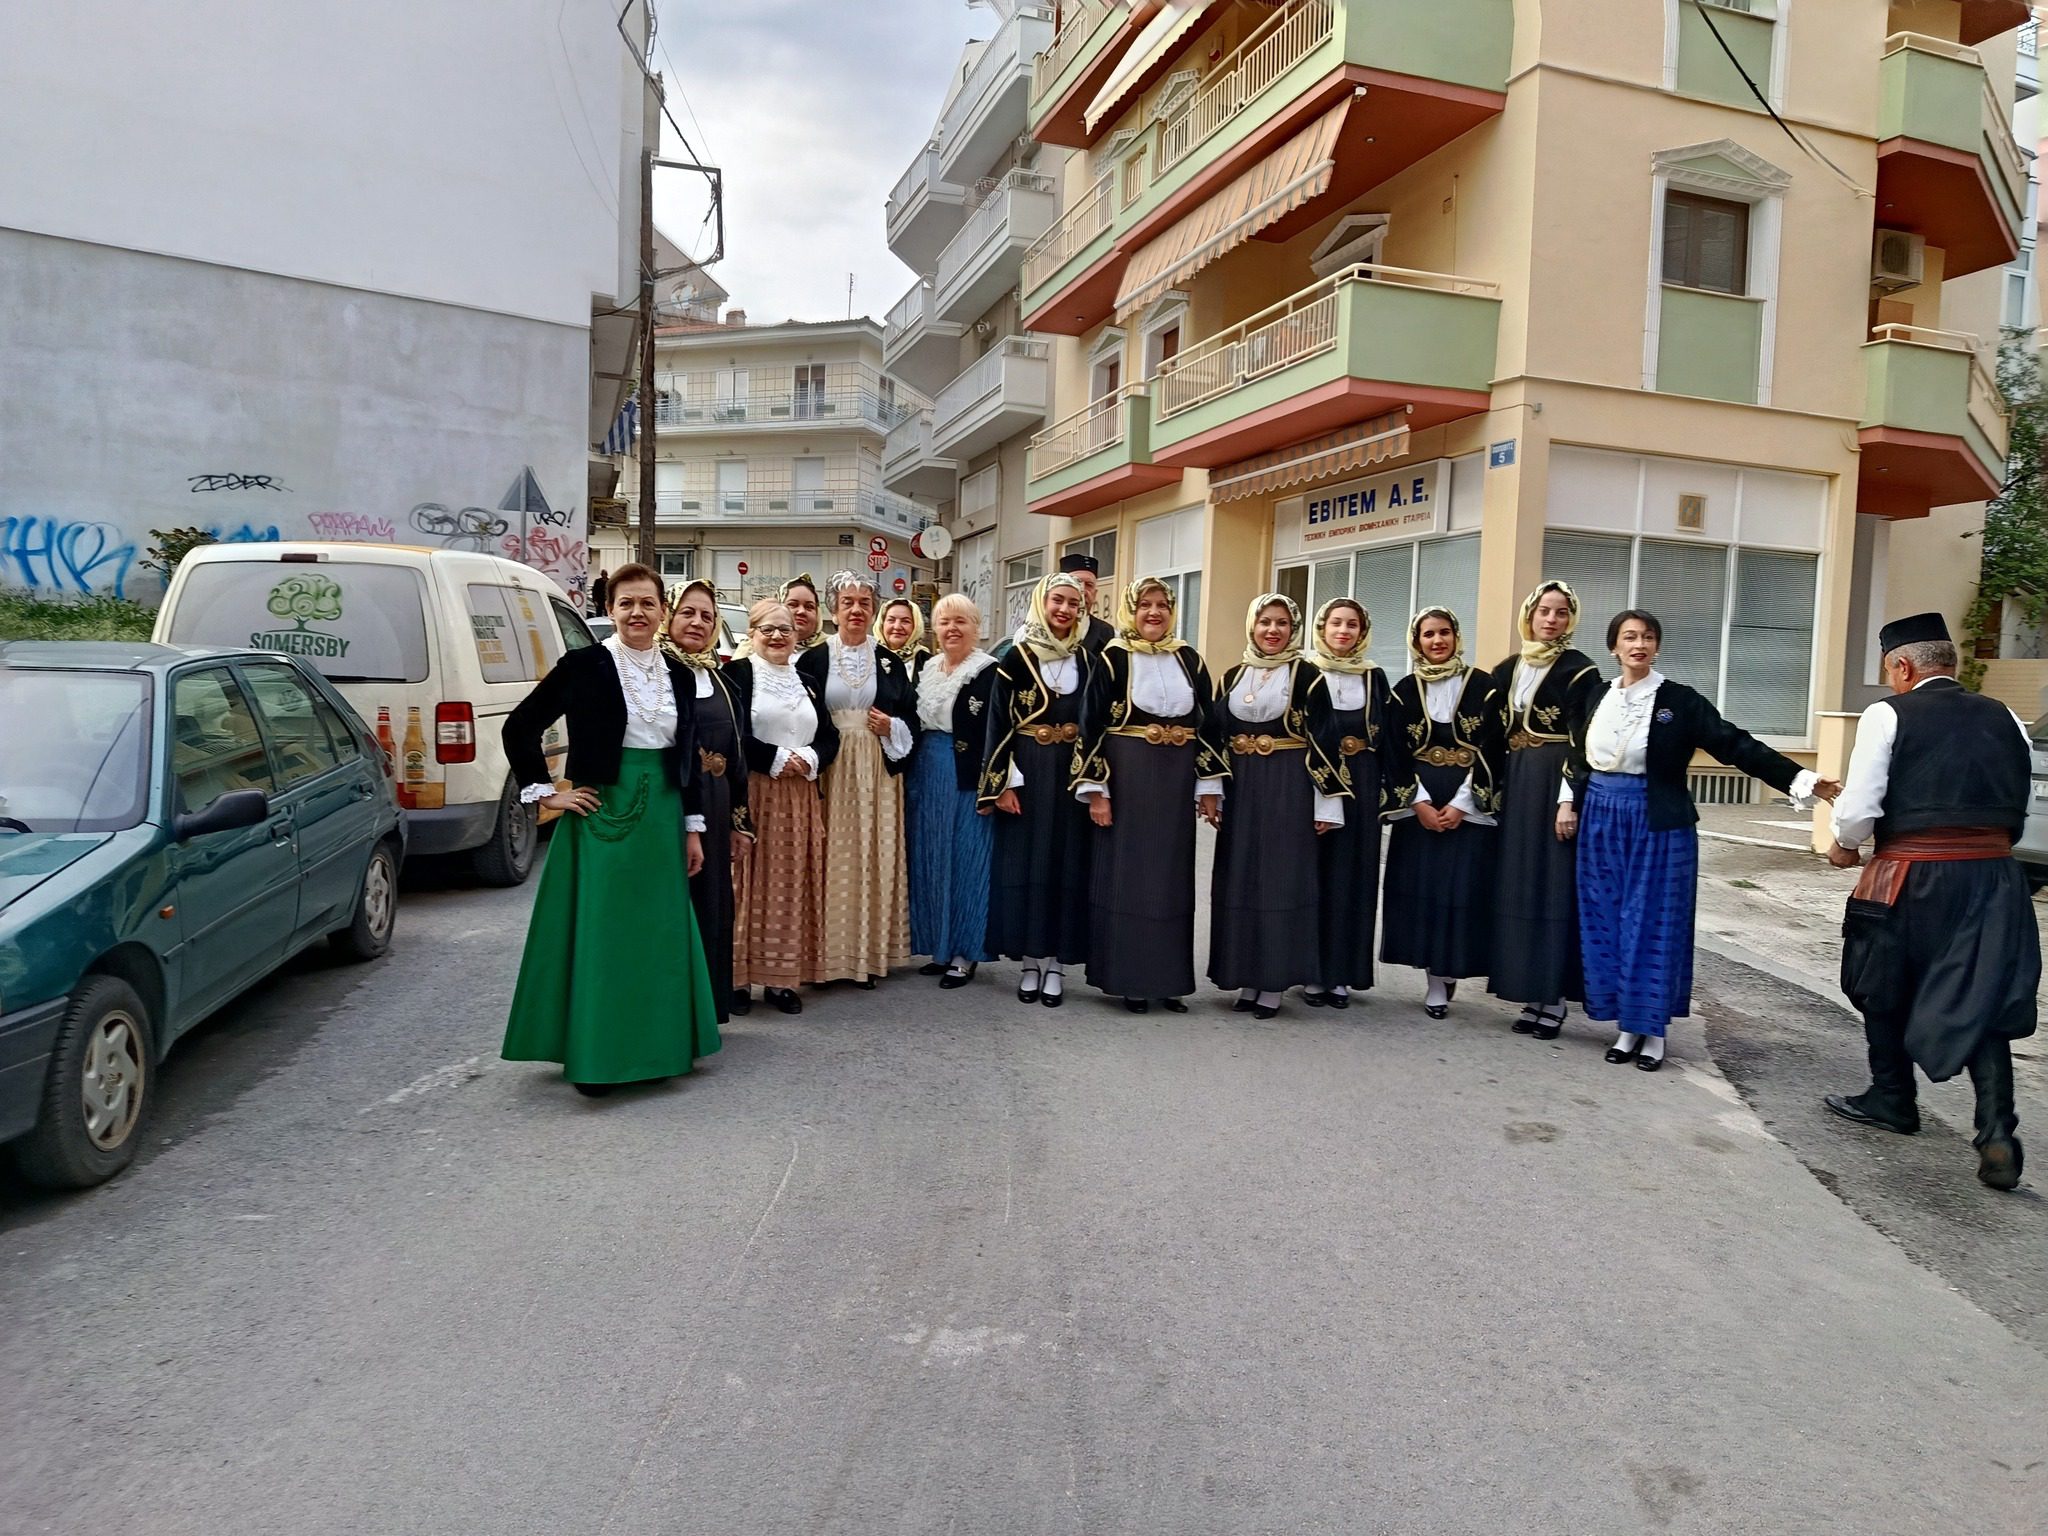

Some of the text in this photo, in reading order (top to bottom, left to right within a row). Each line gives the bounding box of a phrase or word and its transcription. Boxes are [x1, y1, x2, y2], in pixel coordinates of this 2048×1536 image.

[1498, 452, 1505, 464] 5
[868, 555, 888, 567] STOP
[249, 632, 350, 658] SOMERSBY
